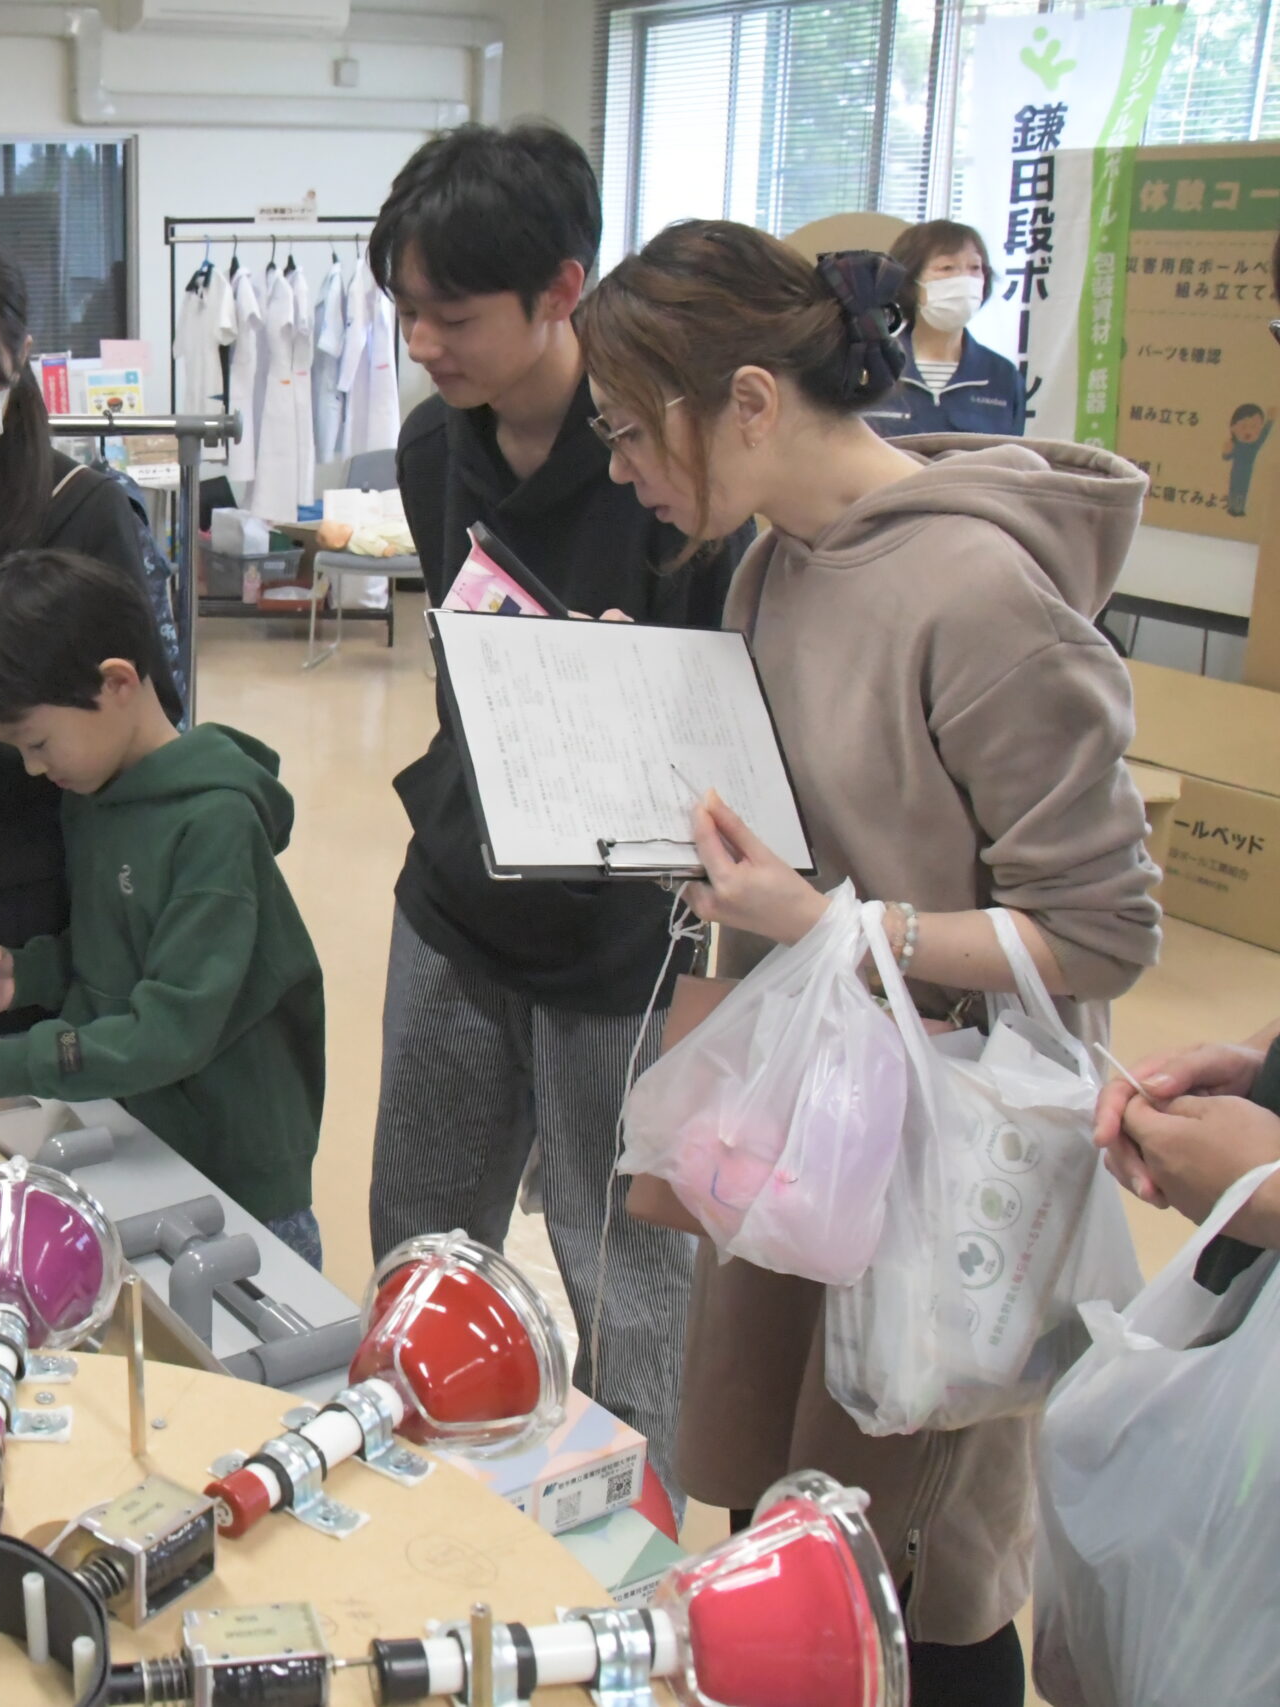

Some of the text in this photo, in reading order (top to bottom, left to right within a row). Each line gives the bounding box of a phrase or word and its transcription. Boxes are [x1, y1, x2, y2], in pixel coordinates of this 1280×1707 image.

[1002, 101, 1068, 418] 鎌田段ボール
[1146, 485, 1233, 511] に寝てみよう
[1174, 820, 1265, 854] ールベッド
